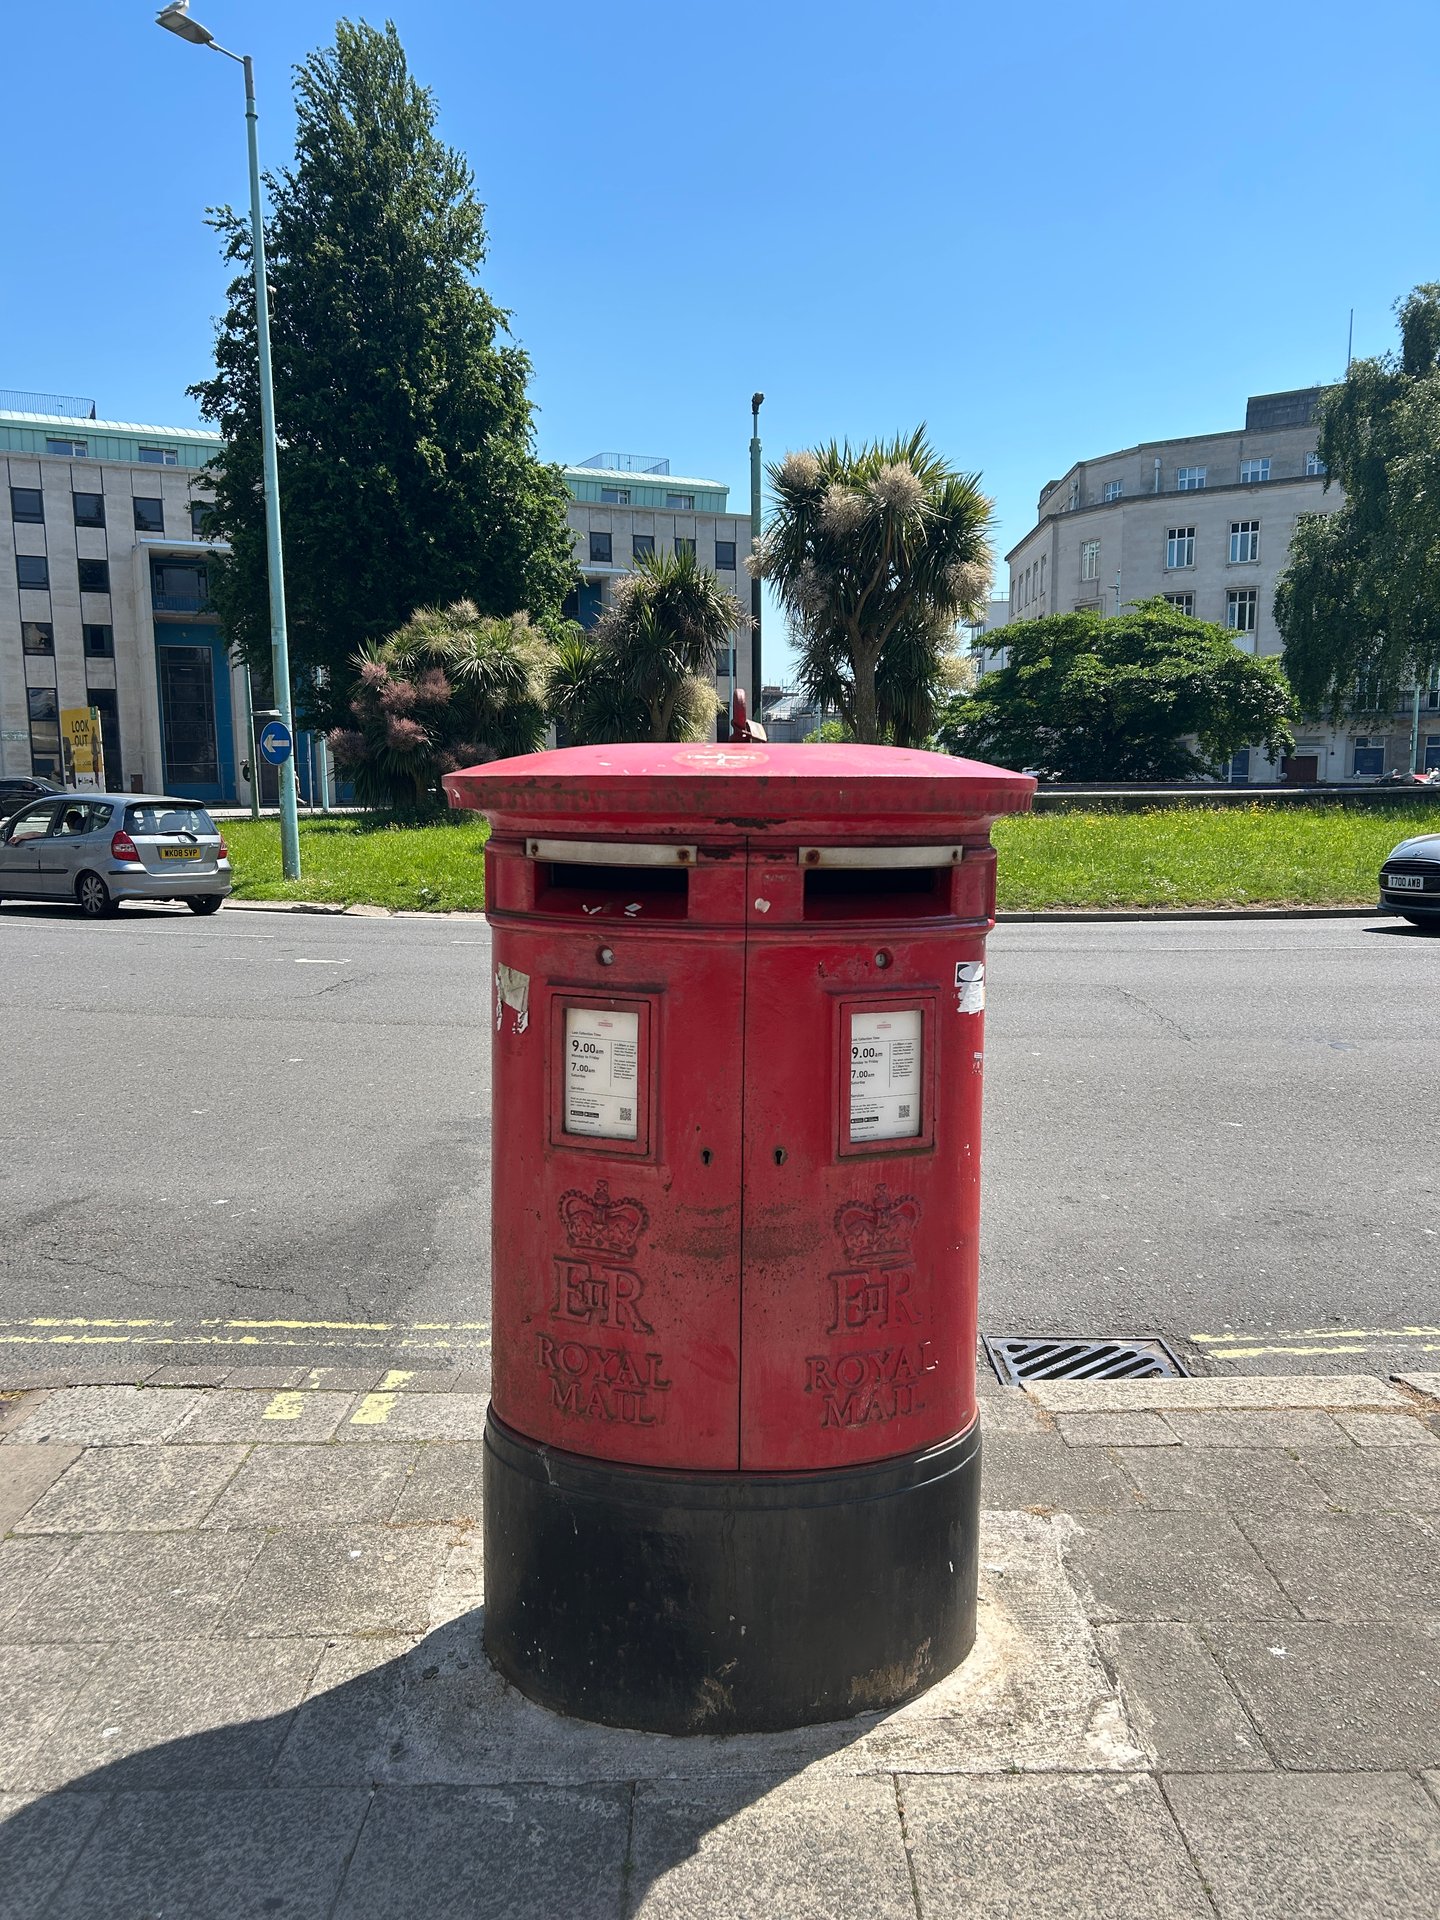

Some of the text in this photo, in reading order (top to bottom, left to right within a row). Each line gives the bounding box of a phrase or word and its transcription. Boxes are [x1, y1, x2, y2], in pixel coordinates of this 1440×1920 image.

[71, 719, 90, 733] LOOK
[74, 734, 89, 747] OUT
[184, 849, 198, 857] SVP
[1390, 876, 1406, 887] T700
[572, 1039, 604, 1054] 9.00am
[851, 1046, 883, 1059] 9.00am
[571, 1062, 595, 1073] 7.00am
[535, 1330, 672, 1392] ROYAL
[804, 1340, 940, 1393] ROYAL
[548, 1375, 656, 1426] MAIL
[821, 1380, 926, 1429] MAIL
